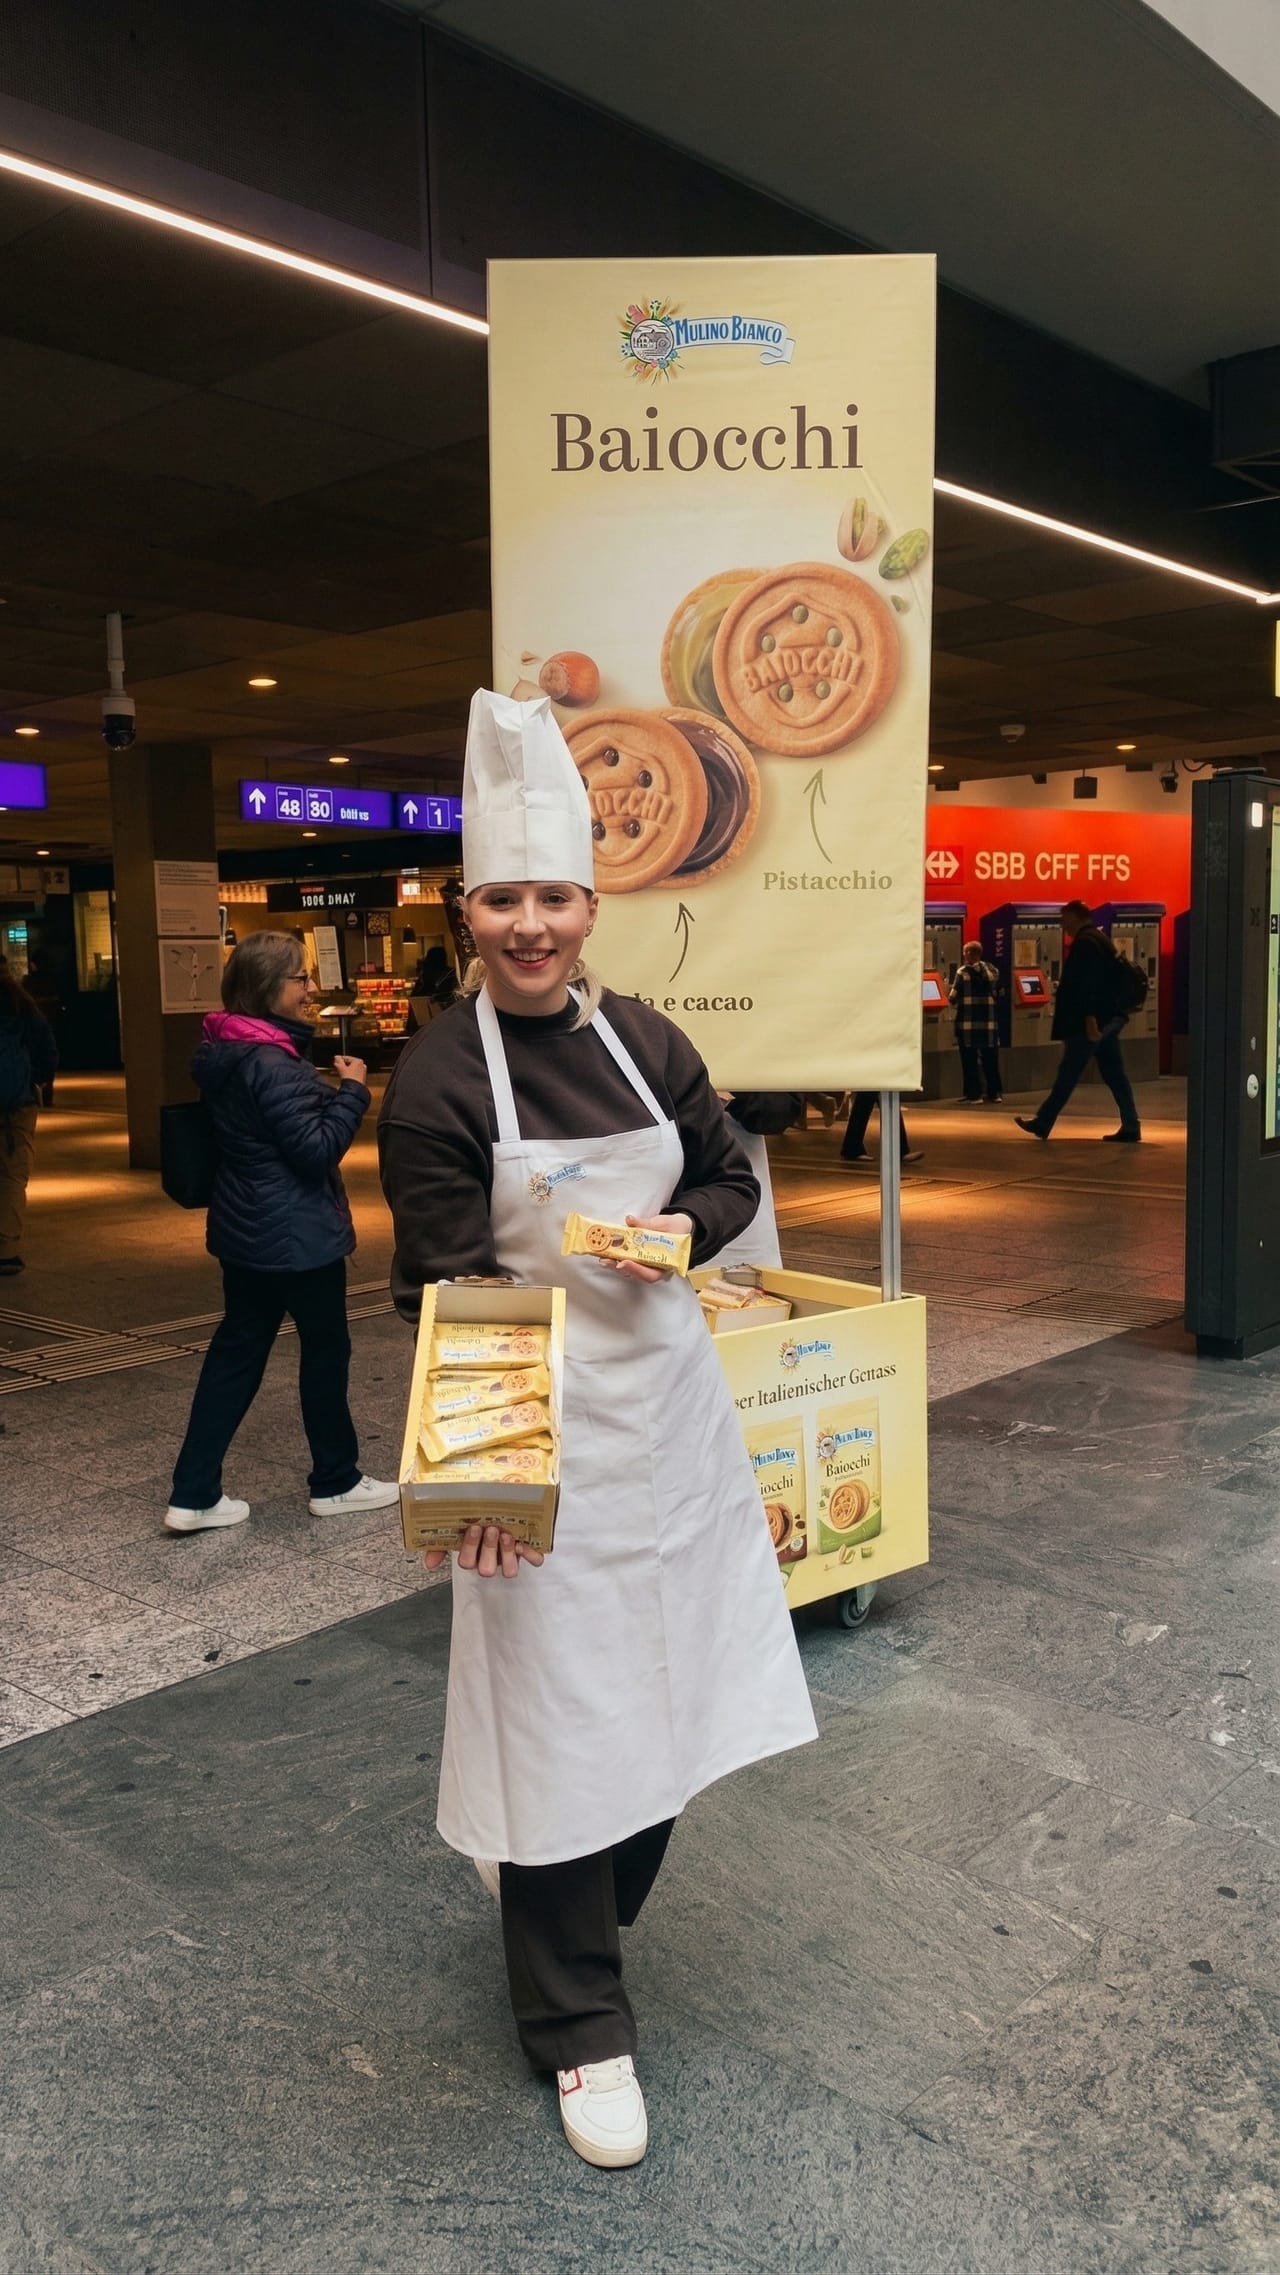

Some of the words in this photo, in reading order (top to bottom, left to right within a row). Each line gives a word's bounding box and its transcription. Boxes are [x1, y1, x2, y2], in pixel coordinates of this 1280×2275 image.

[674, 318, 729, 346] MULINO
[731, 315, 782, 344] BIANCO
[550, 403, 864, 473] Baiocchi
[763, 870, 893, 890] Pistacchio
[974, 851, 1026, 881] SBB
[1035, 851, 1080, 882] CFF
[1087, 853, 1131, 882] FFS
[663, 996, 677, 1012] e
[682, 996, 754, 1012] cacao
[757, 1373, 847, 1406] Italienischer
[825, 1453, 871, 1478] Baiocchi
[760, 1473, 794, 1496] iocchi
